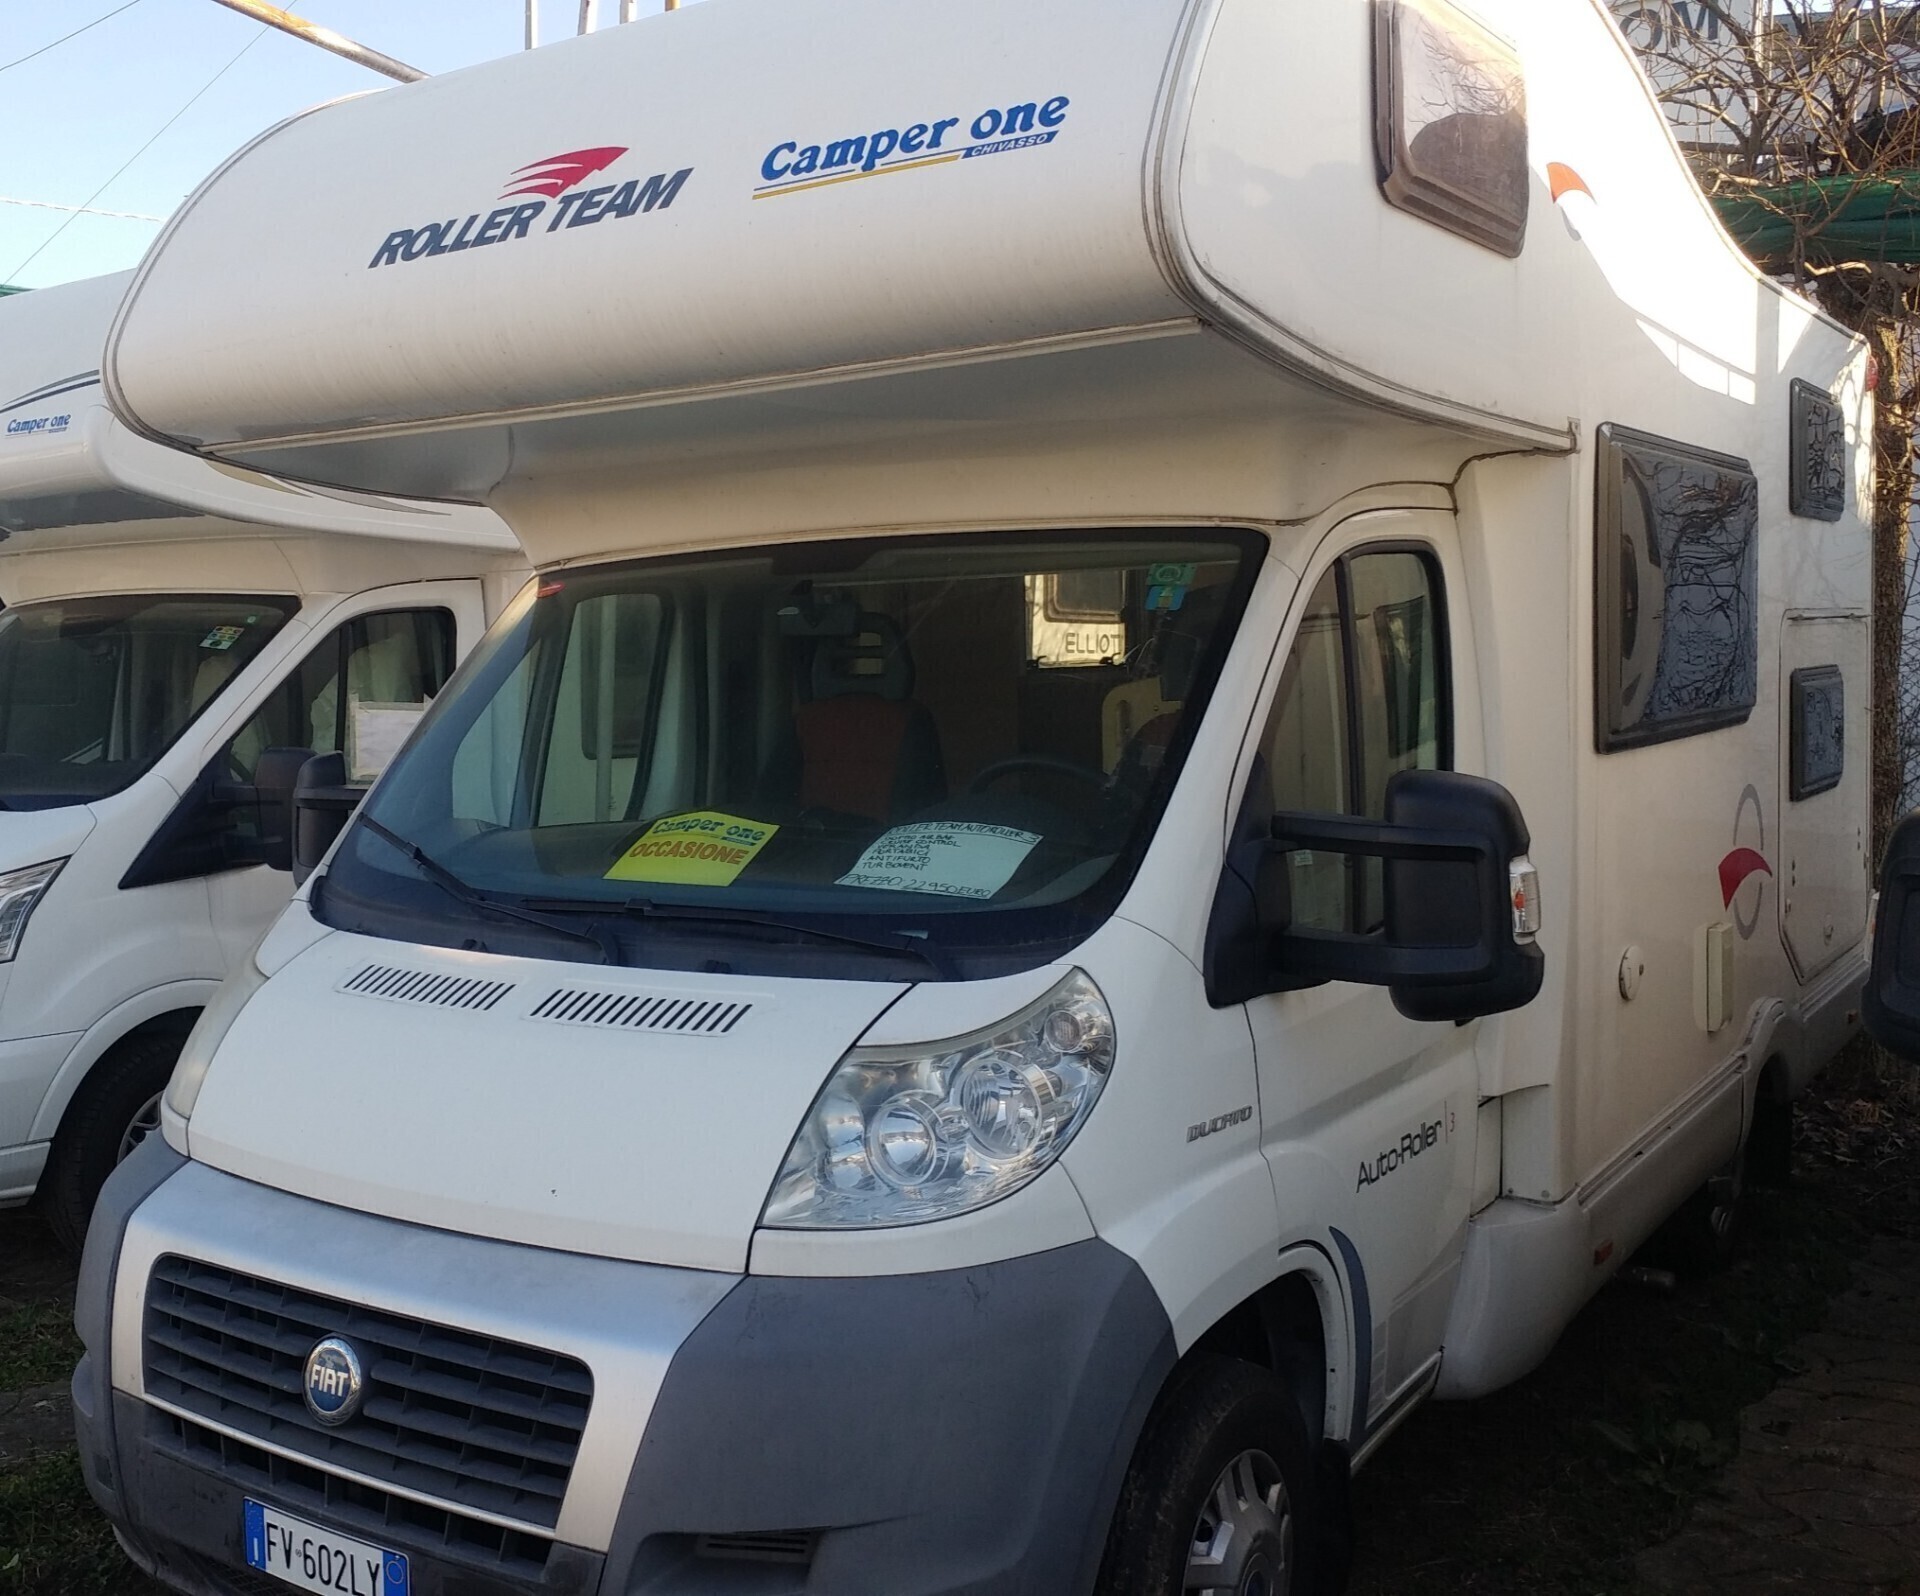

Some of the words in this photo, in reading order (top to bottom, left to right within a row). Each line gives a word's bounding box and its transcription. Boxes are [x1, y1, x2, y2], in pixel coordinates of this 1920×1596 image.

[760, 116, 961, 181] Camper
[969, 95, 1070, 144] one
[970, 131, 1052, 158] CHIVASSO
[367, 201, 547, 269] ROLLER
[546, 167, 695, 233] TEAM
[7, 417, 50, 434] Camper
[50, 413, 72, 428] one
[653, 819, 725, 834] Camper
[725, 824, 766, 841] one
[916, 840, 962, 848] CONTROL
[630, 841, 750, 865] OCCASIONE
[1186, 1105, 1253, 1143] DUCATO
[1356, 1119, 1442, 1194] Auto-Roller
[309, 1363, 349, 1397] FIAT
